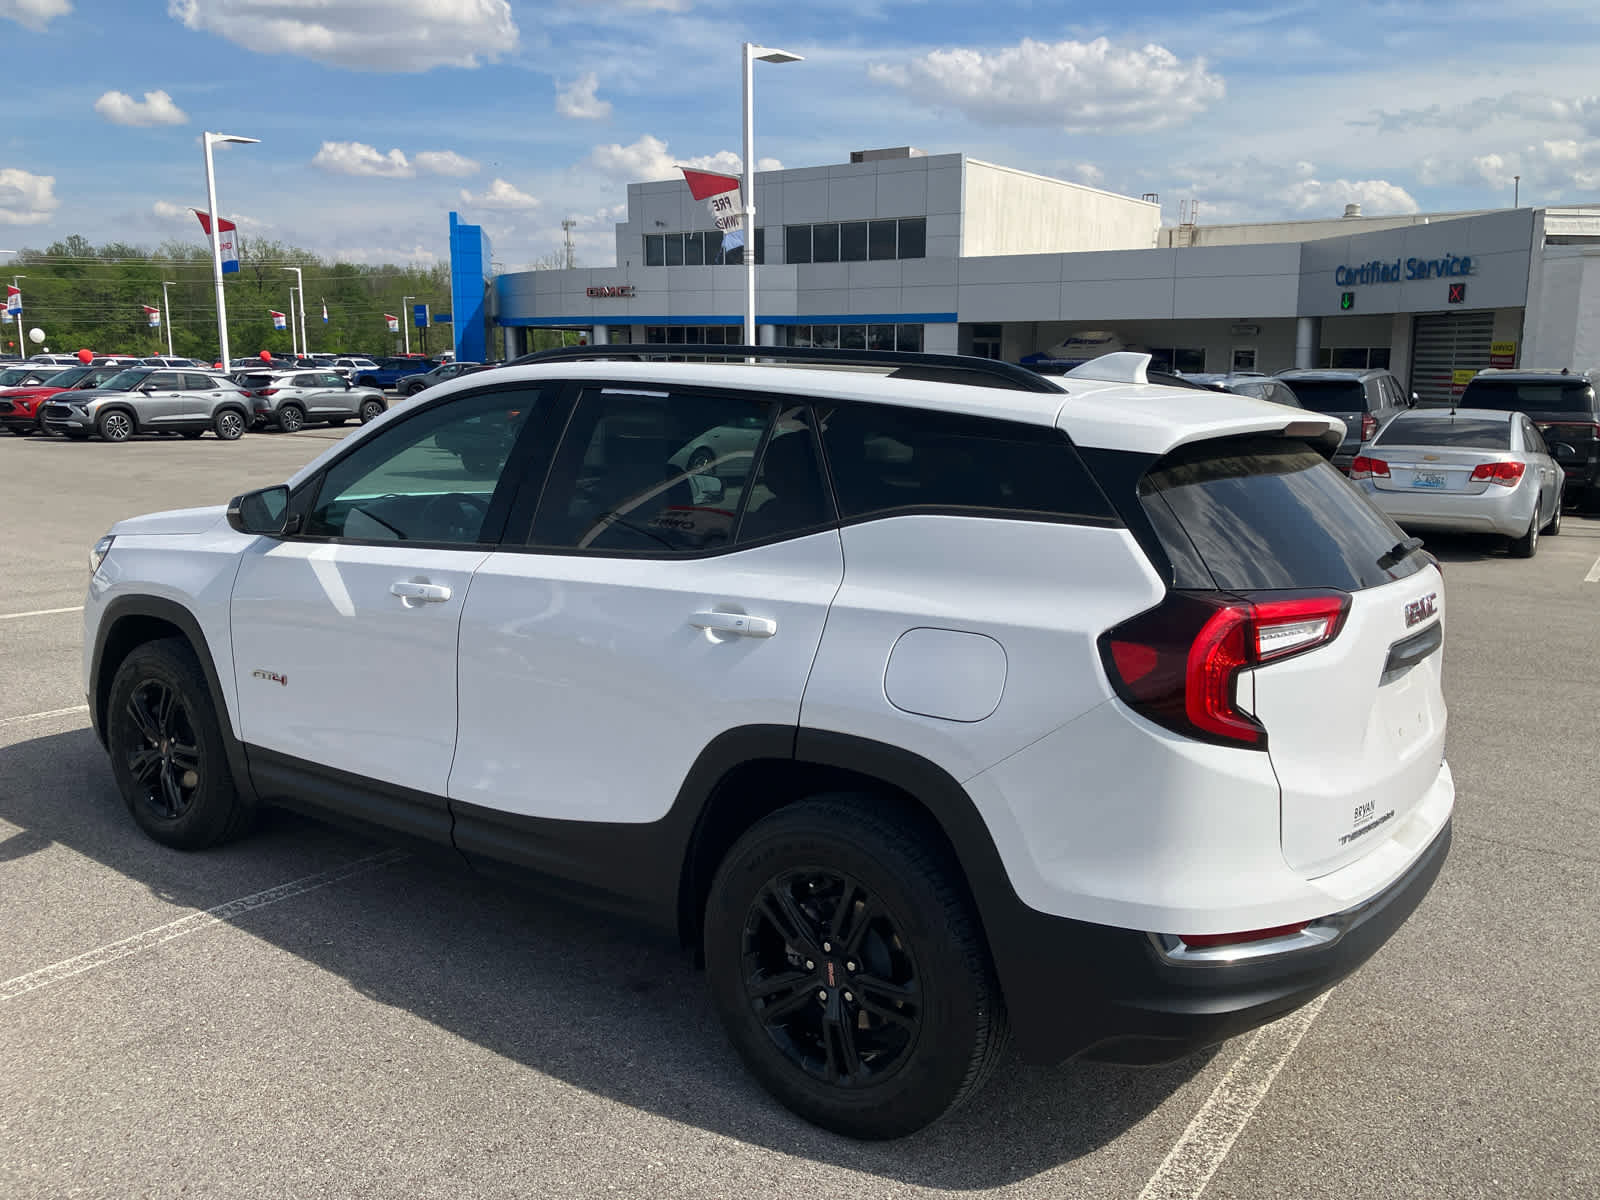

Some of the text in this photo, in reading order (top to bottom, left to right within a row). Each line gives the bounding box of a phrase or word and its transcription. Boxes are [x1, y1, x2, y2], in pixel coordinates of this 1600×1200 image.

[1335, 252, 1472, 287] Certified Service
[586, 286, 636, 297] GMC
[1405, 593, 1438, 628] GMC
[1354, 800, 1375, 819] BRYAN
